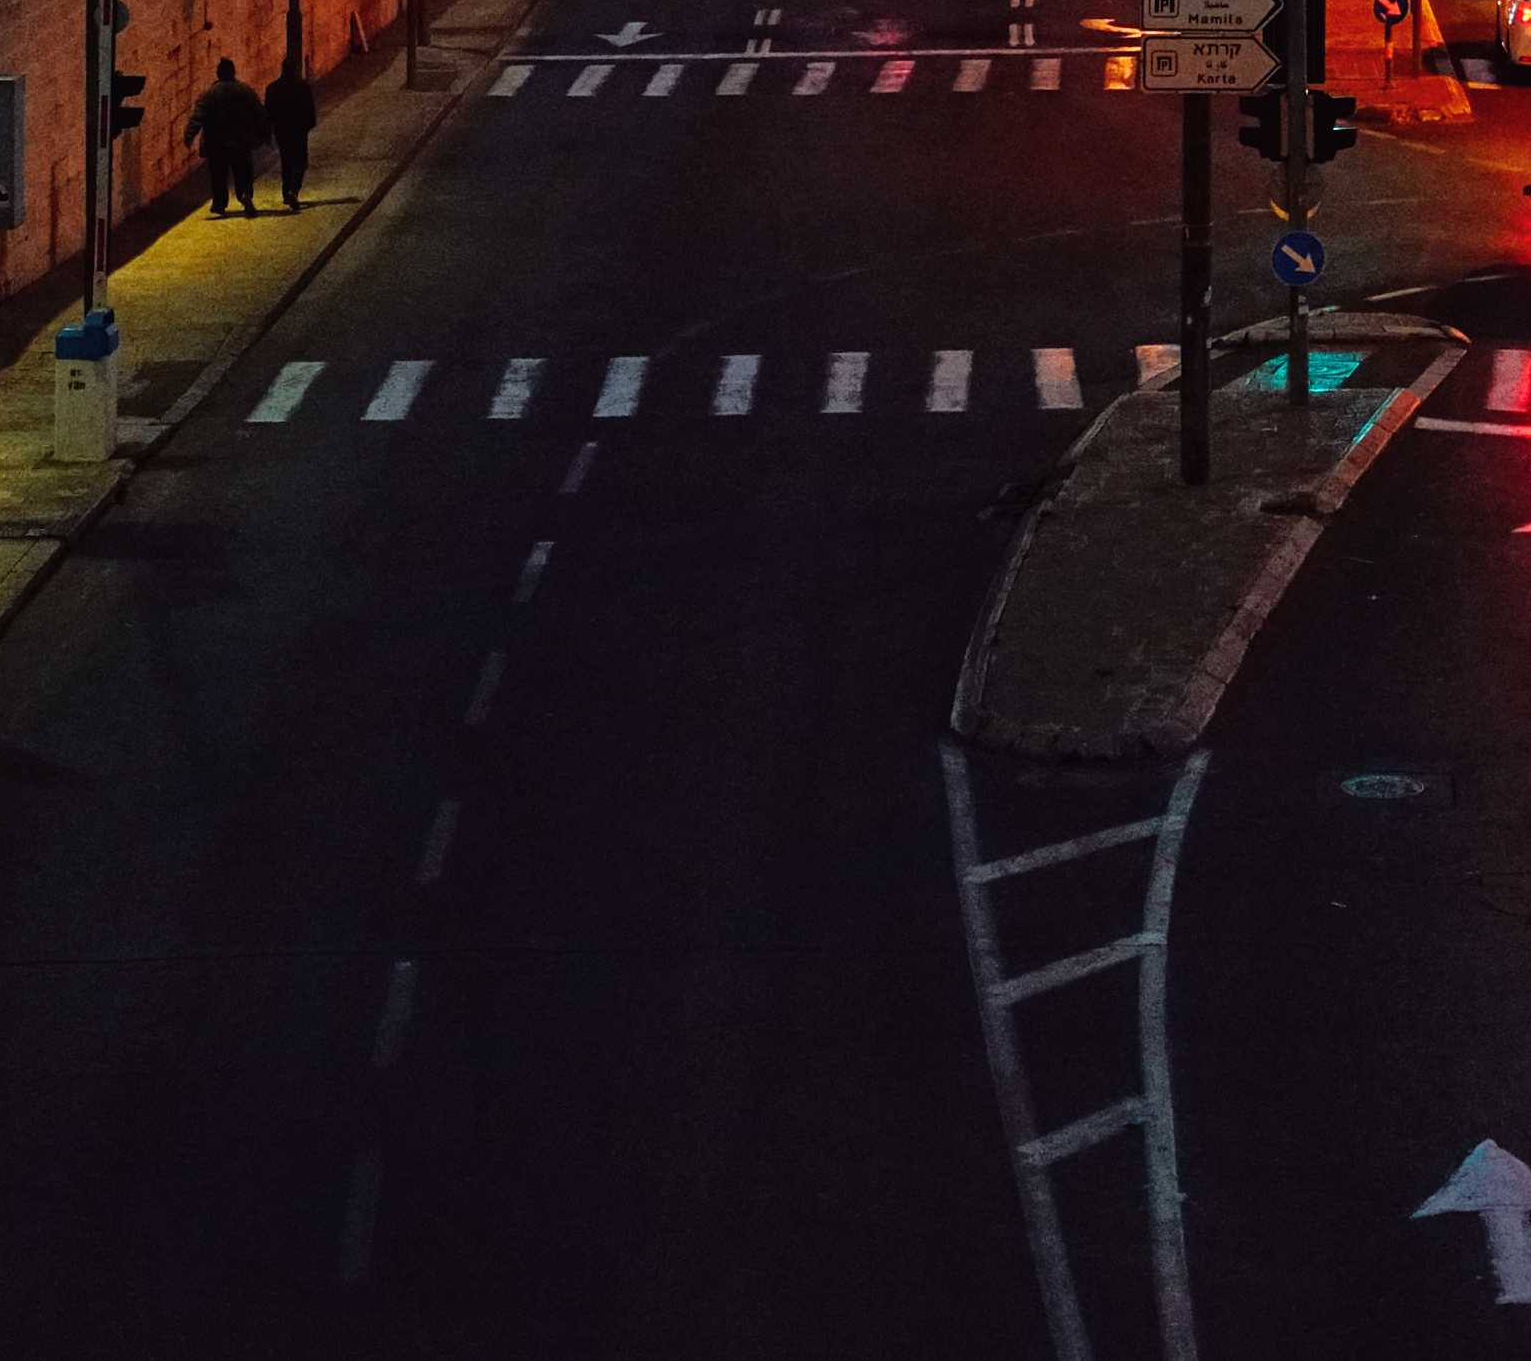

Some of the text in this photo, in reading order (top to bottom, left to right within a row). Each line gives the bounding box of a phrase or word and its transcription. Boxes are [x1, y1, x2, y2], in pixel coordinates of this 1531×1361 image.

[1188, 14, 1243, 25] Mamila
[1193, 43, 1242, 59] קרתא
[1197, 73, 1236, 84] Karta
